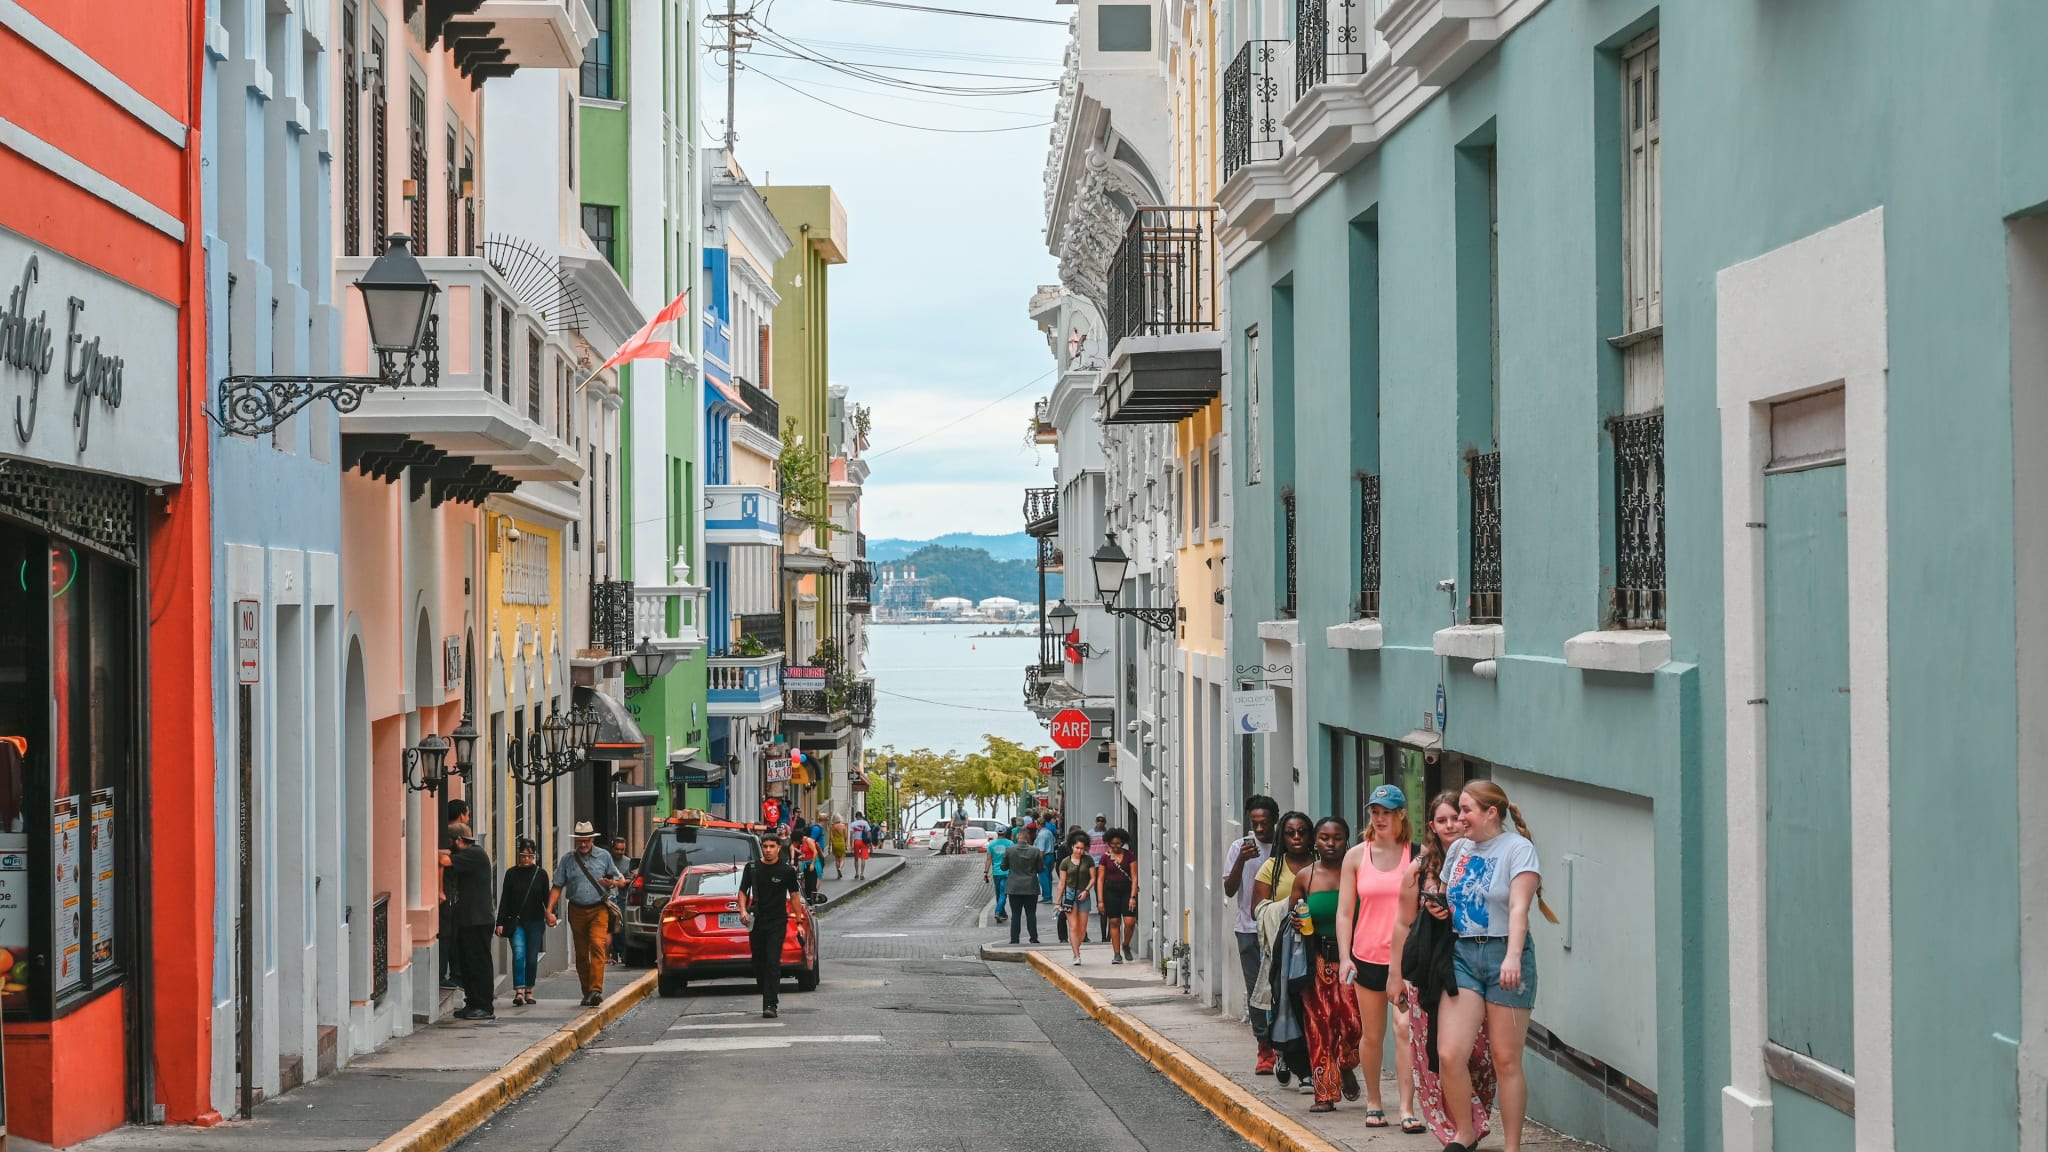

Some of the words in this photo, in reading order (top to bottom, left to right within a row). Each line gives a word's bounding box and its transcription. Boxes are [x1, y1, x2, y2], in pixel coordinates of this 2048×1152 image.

[243, 611, 254, 631] NO
[1052, 722, 1089, 737] PARE
[768, 768, 774, 778] 4
[783, 766, 792, 777] 10
